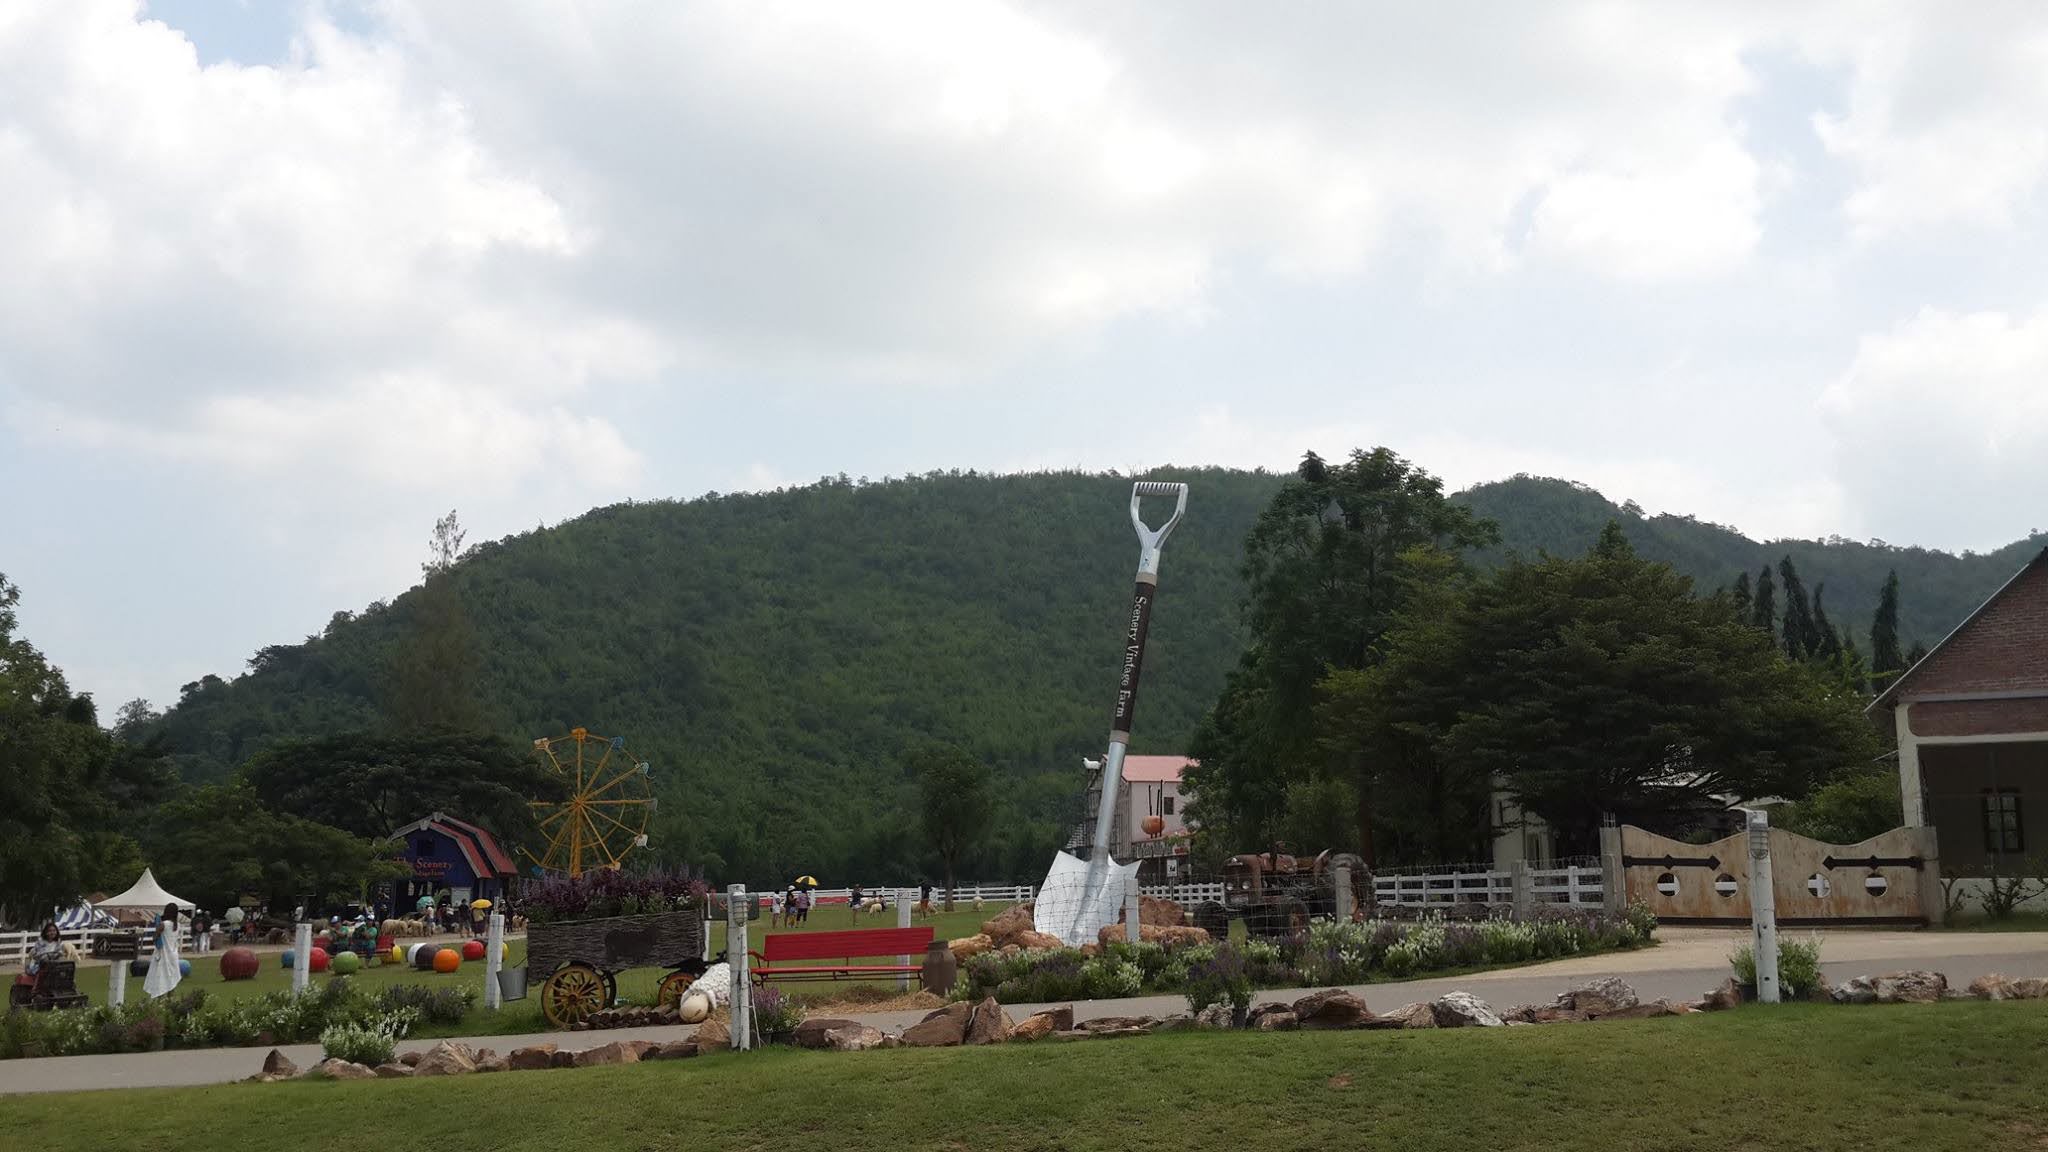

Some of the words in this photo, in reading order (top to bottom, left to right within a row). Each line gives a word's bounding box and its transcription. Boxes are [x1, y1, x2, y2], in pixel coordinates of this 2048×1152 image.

[1128, 596, 1147, 640] Scenery
[1121, 645, 1139, 686] Vintage
[1116, 690, 1131, 718] Farm
[416, 857, 453, 870] Scenery
